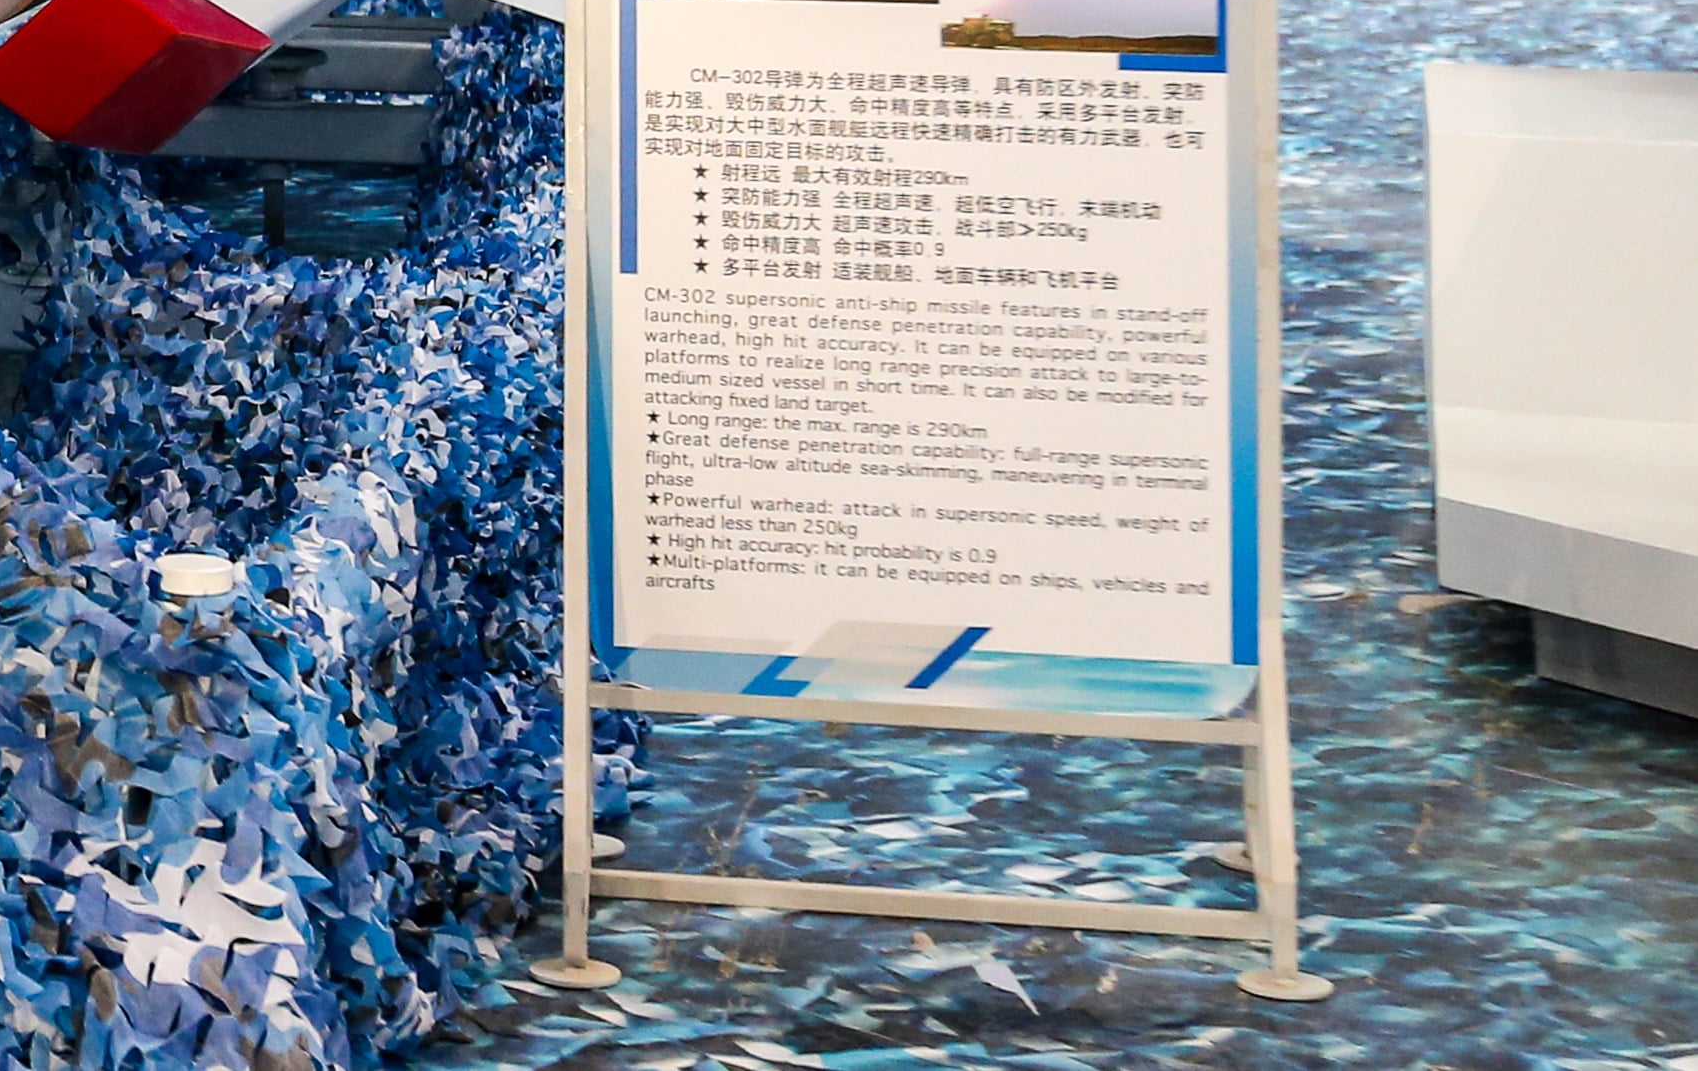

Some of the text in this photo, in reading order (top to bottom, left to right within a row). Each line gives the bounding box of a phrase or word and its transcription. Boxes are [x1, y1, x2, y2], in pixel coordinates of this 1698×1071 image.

[721, 234, 821, 256] 命中精度高
[722, 257, 822, 279] 多平台发射
[644, 287, 1208, 324] CM-302 supersonic anti-ship missile features in stand-off
[644, 307, 739, 327] launching,
[749, 314, 797, 330] great
[808, 315, 882, 331] defense
[892, 318, 1003, 337] penetration
[1123, 328, 1208, 345] powerful
[644, 330, 726, 347] warhead,
[735, 333, 774, 349] high
[784, 334, 807, 349] hit
[915, 340, 928, 354] It
[938, 341, 970, 355] can
[980, 342, 1002, 357] be
[1011, 345, 1097, 363] equipped
[1107, 349, 1130, 362] on
[1139, 349, 1208, 366] various
[644, 349, 1209, 388] platforms to realize long range precision attack to large-to-
[644, 371, 712, 385] medium
[719, 372, 764, 388] sized
[773, 375, 826, 390] vessel
[833, 378, 849, 391] in
[856, 378, 902, 394] short
[963, 383, 976, 397] It
[984, 386, 1015, 399] can
[1023, 385, 1058, 401] also
[1067, 387, 1089, 402] be
[1097, 389, 1174, 406] modified
[1182, 391, 1208, 407] for
[644, 390, 873, 415] attacking fixed land target.
[668, 411, 709, 430] Long
[715, 415, 768, 431] range:
[774, 416, 801, 430] the
[853, 422, 901, 438] range
[907, 422, 920, 436] is
[926, 422, 988, 439] 290km
[662, 431, 1209, 470] Great defense penetration capability: full-range supersonic
[645, 450, 695, 469] flight,
[702, 454, 778, 470] ultra-low
[786, 457, 852, 474] altitude
[991, 468, 1104, 490] maneuvering
[1112, 473, 1128, 487] in
[1136, 474, 1208, 491] terminal
[645, 471, 695, 488] phase
[645, 514, 858, 540] warhead less than 250kg
[663, 492, 742, 510] Powerful
[750, 496, 834, 514] warhead:
[842, 502, 902, 518] attack
[911, 505, 927, 519] in
[935, 507, 1036, 525] supersonic
[1116, 516, 1181, 533] weight
[1190, 517, 1209, 532] of
[669, 533, 997, 564] High hit accuracy: hit probability is 0.9
[645, 573, 715, 590] aircrafts
[663, 554, 1209, 596] Multi-platforms: it can be equipped on ships, vehicles and
